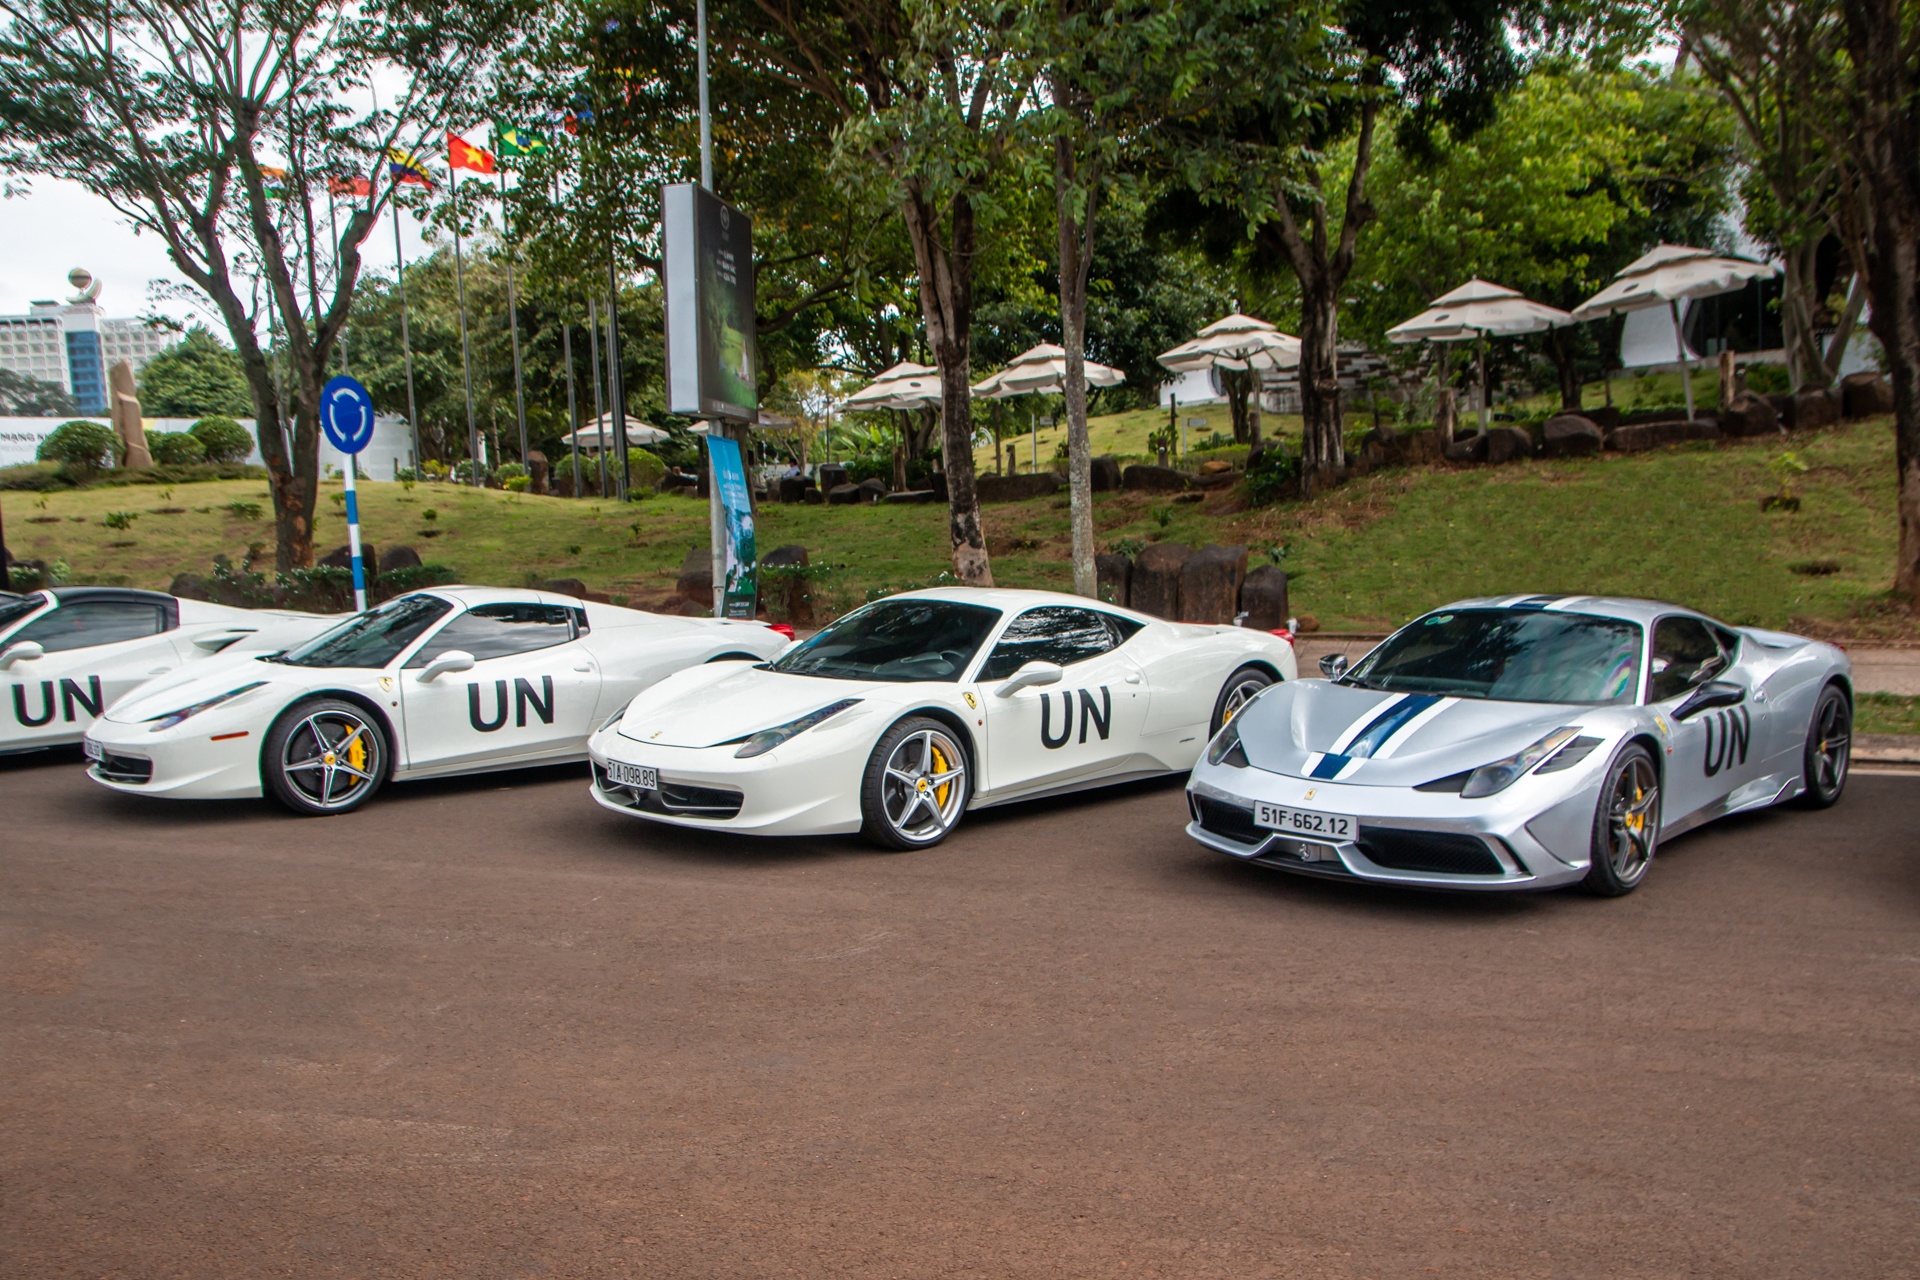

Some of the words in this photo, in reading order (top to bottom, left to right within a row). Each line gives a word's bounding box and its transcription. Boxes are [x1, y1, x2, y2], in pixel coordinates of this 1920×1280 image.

[12, 675, 104, 728] UN
[467, 675, 554, 732] UN
[1040, 685, 1111, 749] UN
[1703, 704, 1750, 778] UN
[607, 762, 655, 787] 51A-098.89
[1261, 806, 1348, 835] 51F-662.12
